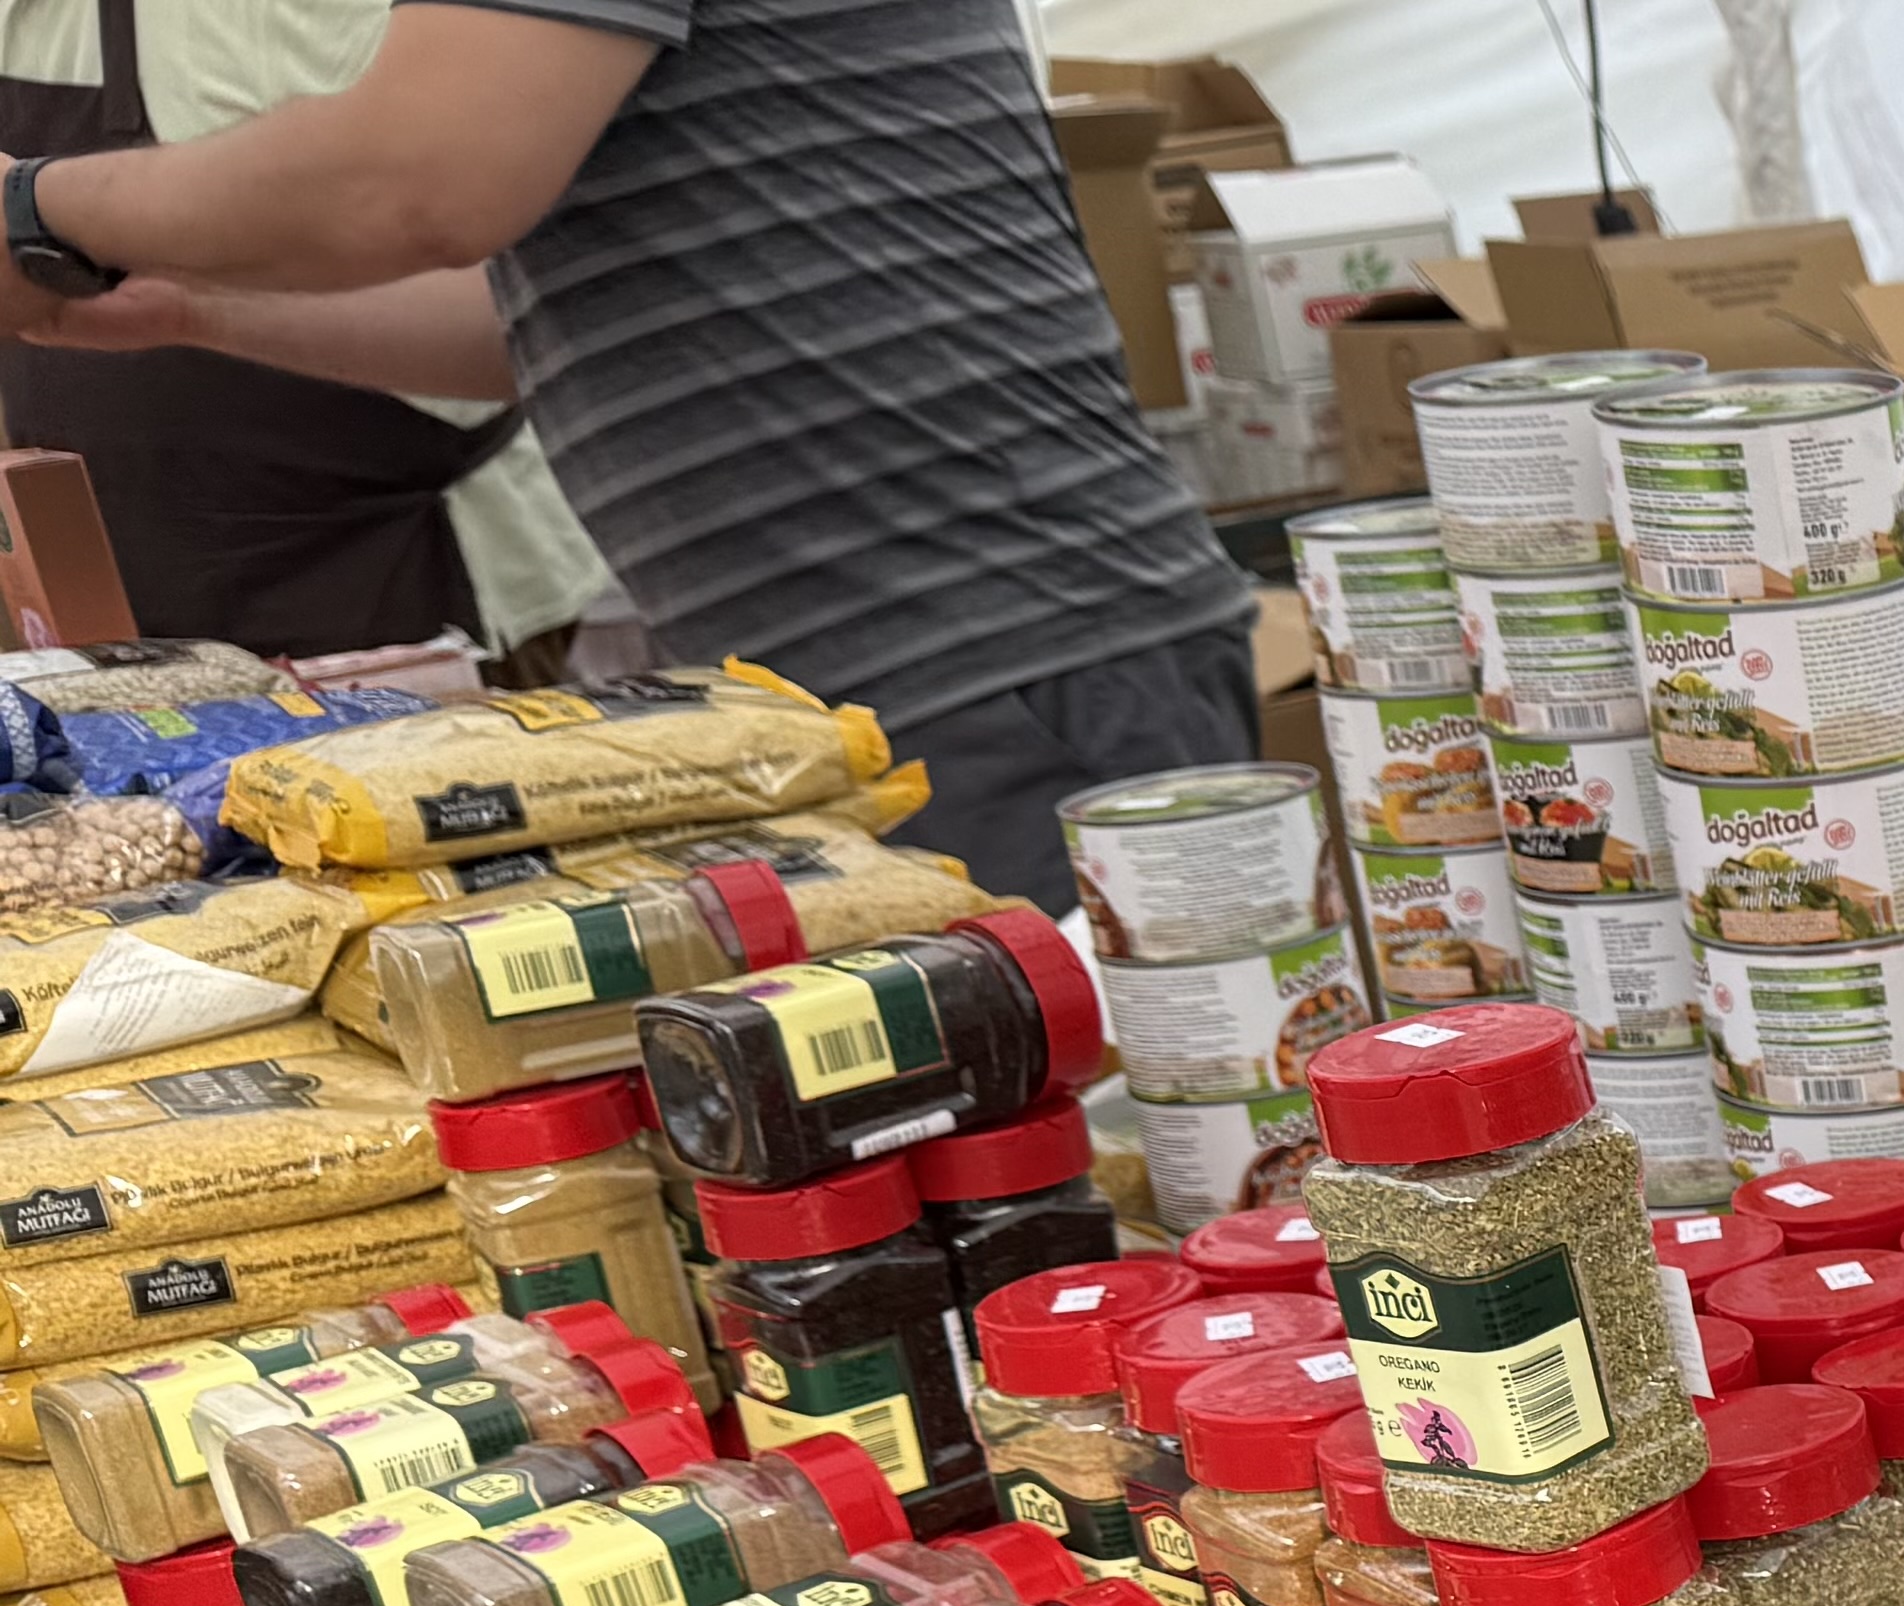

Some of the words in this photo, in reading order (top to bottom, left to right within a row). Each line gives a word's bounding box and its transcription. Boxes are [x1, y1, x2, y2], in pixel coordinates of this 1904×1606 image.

[1385, 718, 1479, 752] doğalta
[1707, 803, 1819, 846] doğaltad
[17, 1197, 82, 1217] ANADOLU
[17, 1208, 91, 1233] MUTFAĞI
[147, 1280, 217, 1304] MUTFAĞI
[1368, 1281, 1433, 1322] inci
[1379, 1354, 1440, 1373] OREGANO
[1397, 1376, 1436, 1392] KEKİK
